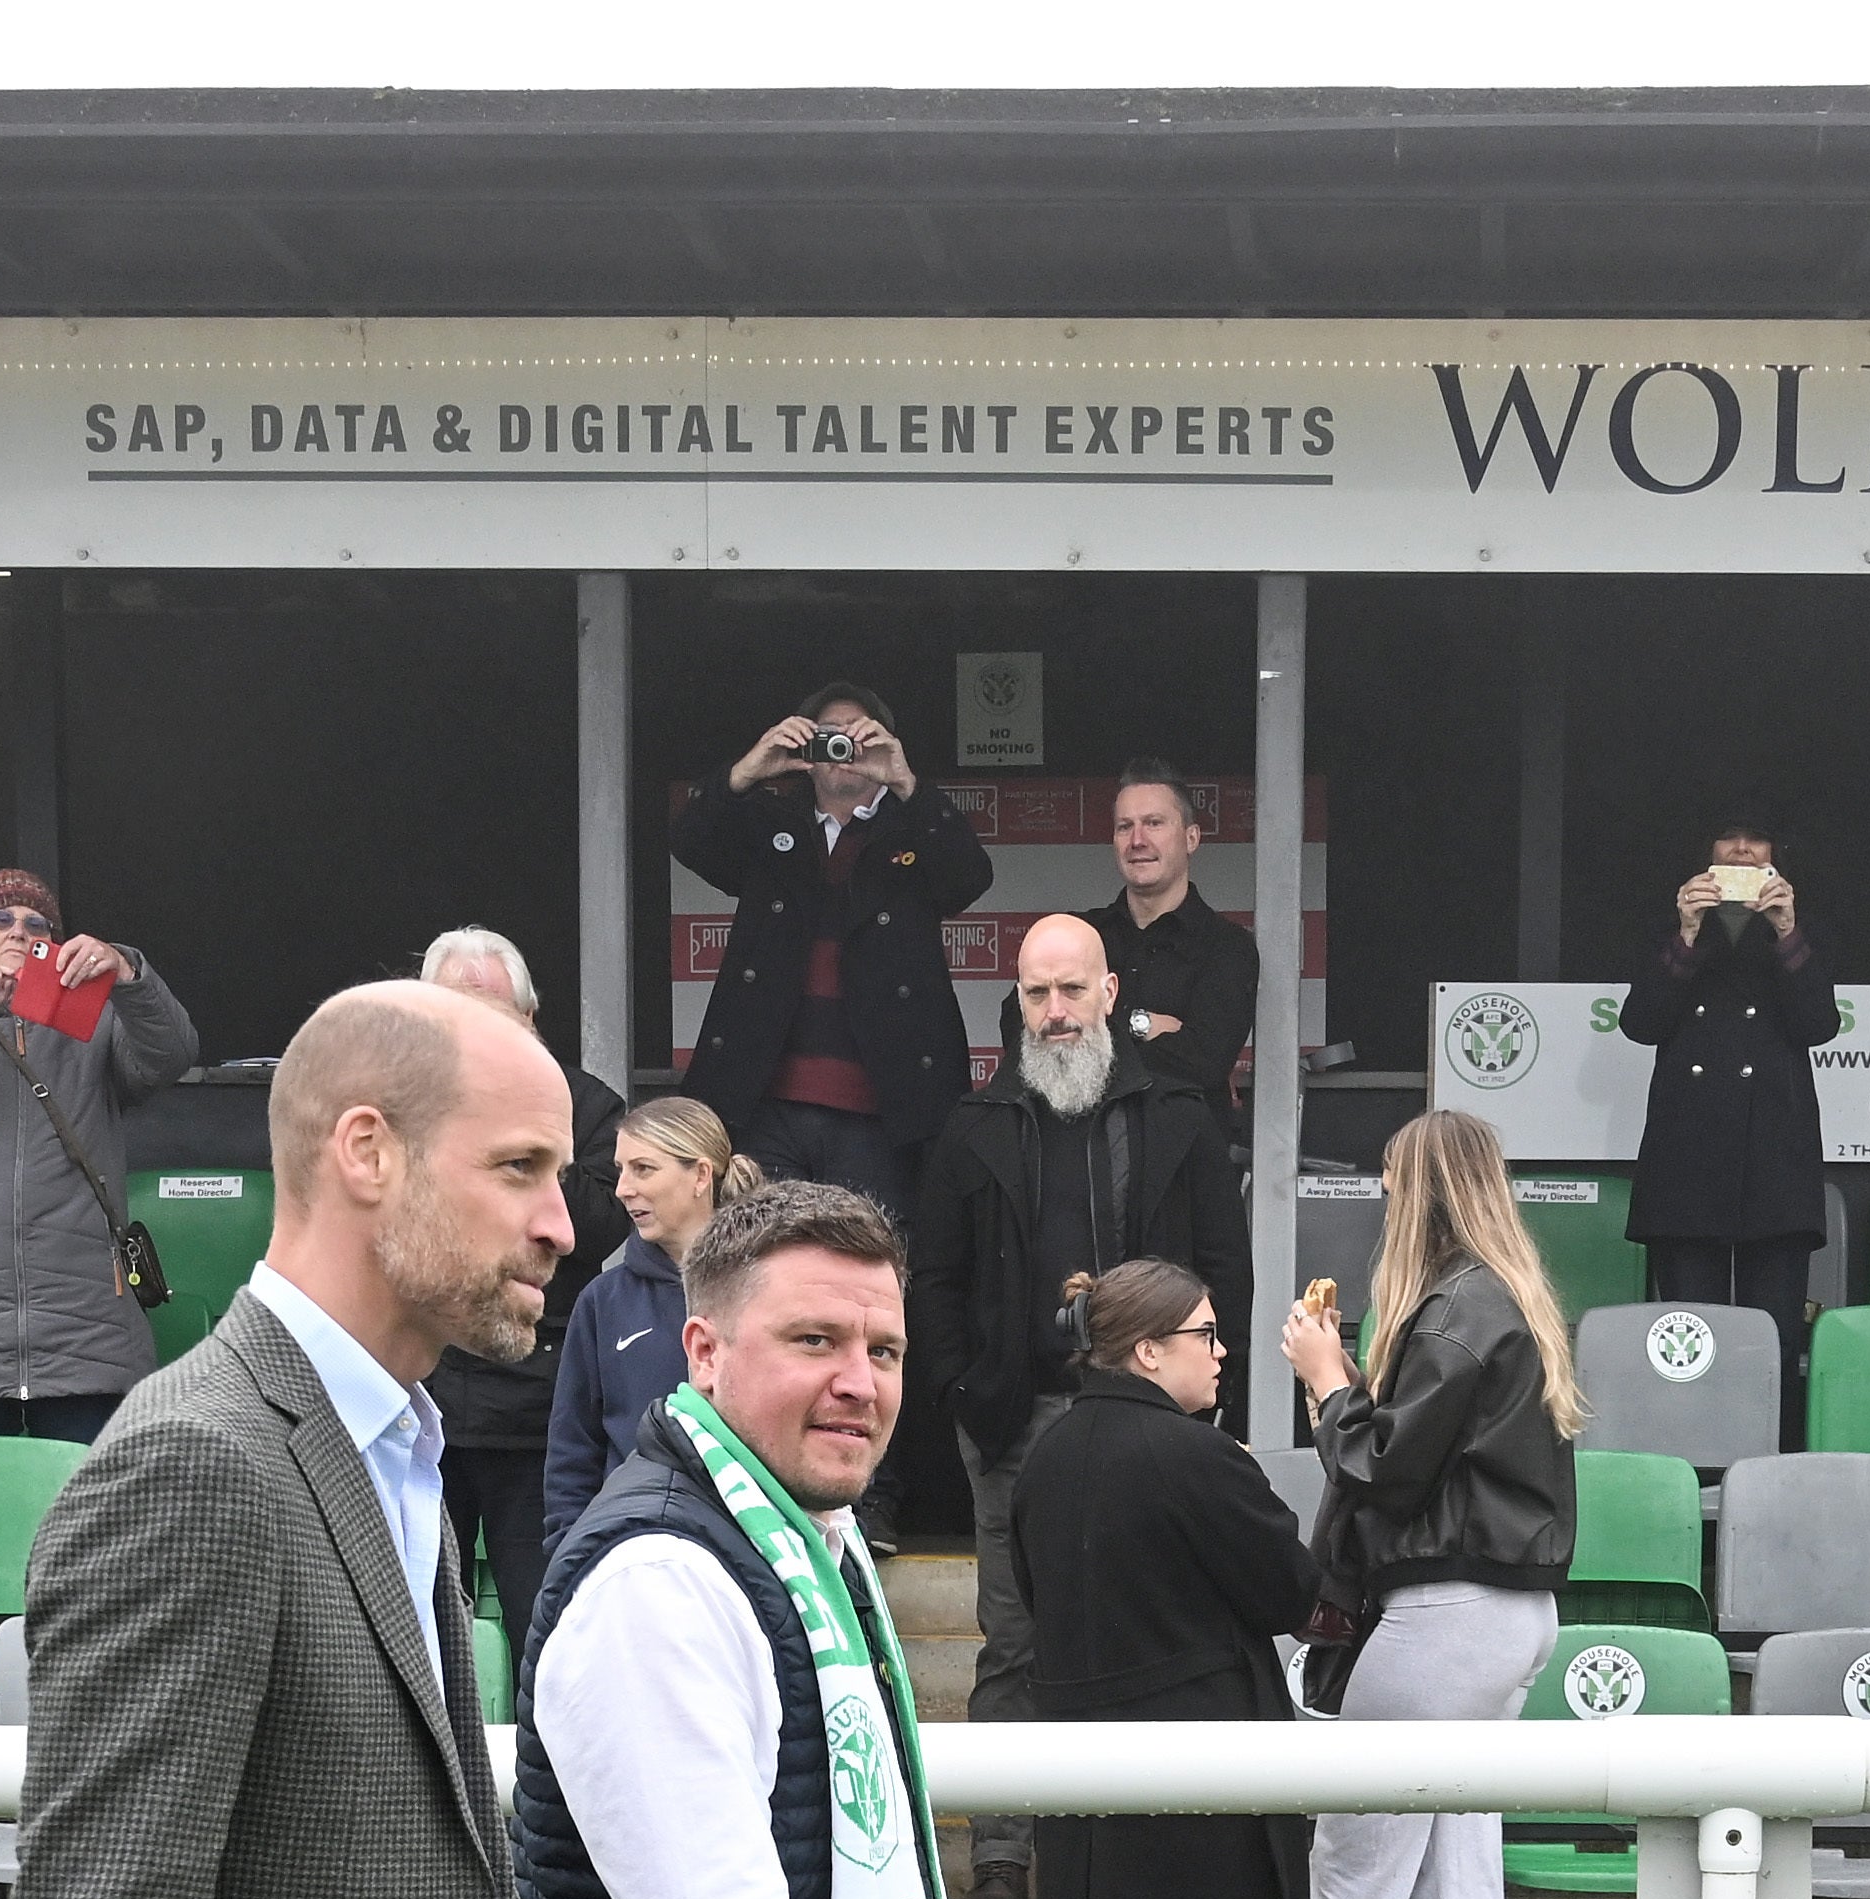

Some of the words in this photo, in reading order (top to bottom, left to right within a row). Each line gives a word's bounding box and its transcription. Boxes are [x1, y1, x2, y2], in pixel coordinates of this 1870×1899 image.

[86, 403, 223, 464] SAP,
[251, 403, 407, 455] DATA
[432, 403, 471, 455] &
[499, 403, 753, 456] DIGITAL
[776, 404, 1017, 456] TALENT
[1045, 405, 1335, 458] EXPERTS
[989, 728, 1011, 739] NO
[966, 743, 1035, 755] SMOKING
[942, 926, 986, 947] CHING
[1451, 997, 1532, 1031] MOUSEHOLE
[1837, 1145, 1846, 1157] 2
[180, 1179, 223, 1187] Reserved
[1316, 1178, 1361, 1186] Reserved
[1533, 1182, 1578, 1190] Reserved
[168, 1189, 195, 1197] Home
[197, 1189, 233, 1197] Director
[1305, 1188, 1332, 1198] Away
[1334, 1187, 1372, 1197] Director
[1522, 1192, 1548, 1202] Away
[1549, 1192, 1588, 1202] Director
[1651, 1314, 1710, 1338] MOUSEHOLE
[1570, 1647, 1640, 1677] MOUSEHOLE
